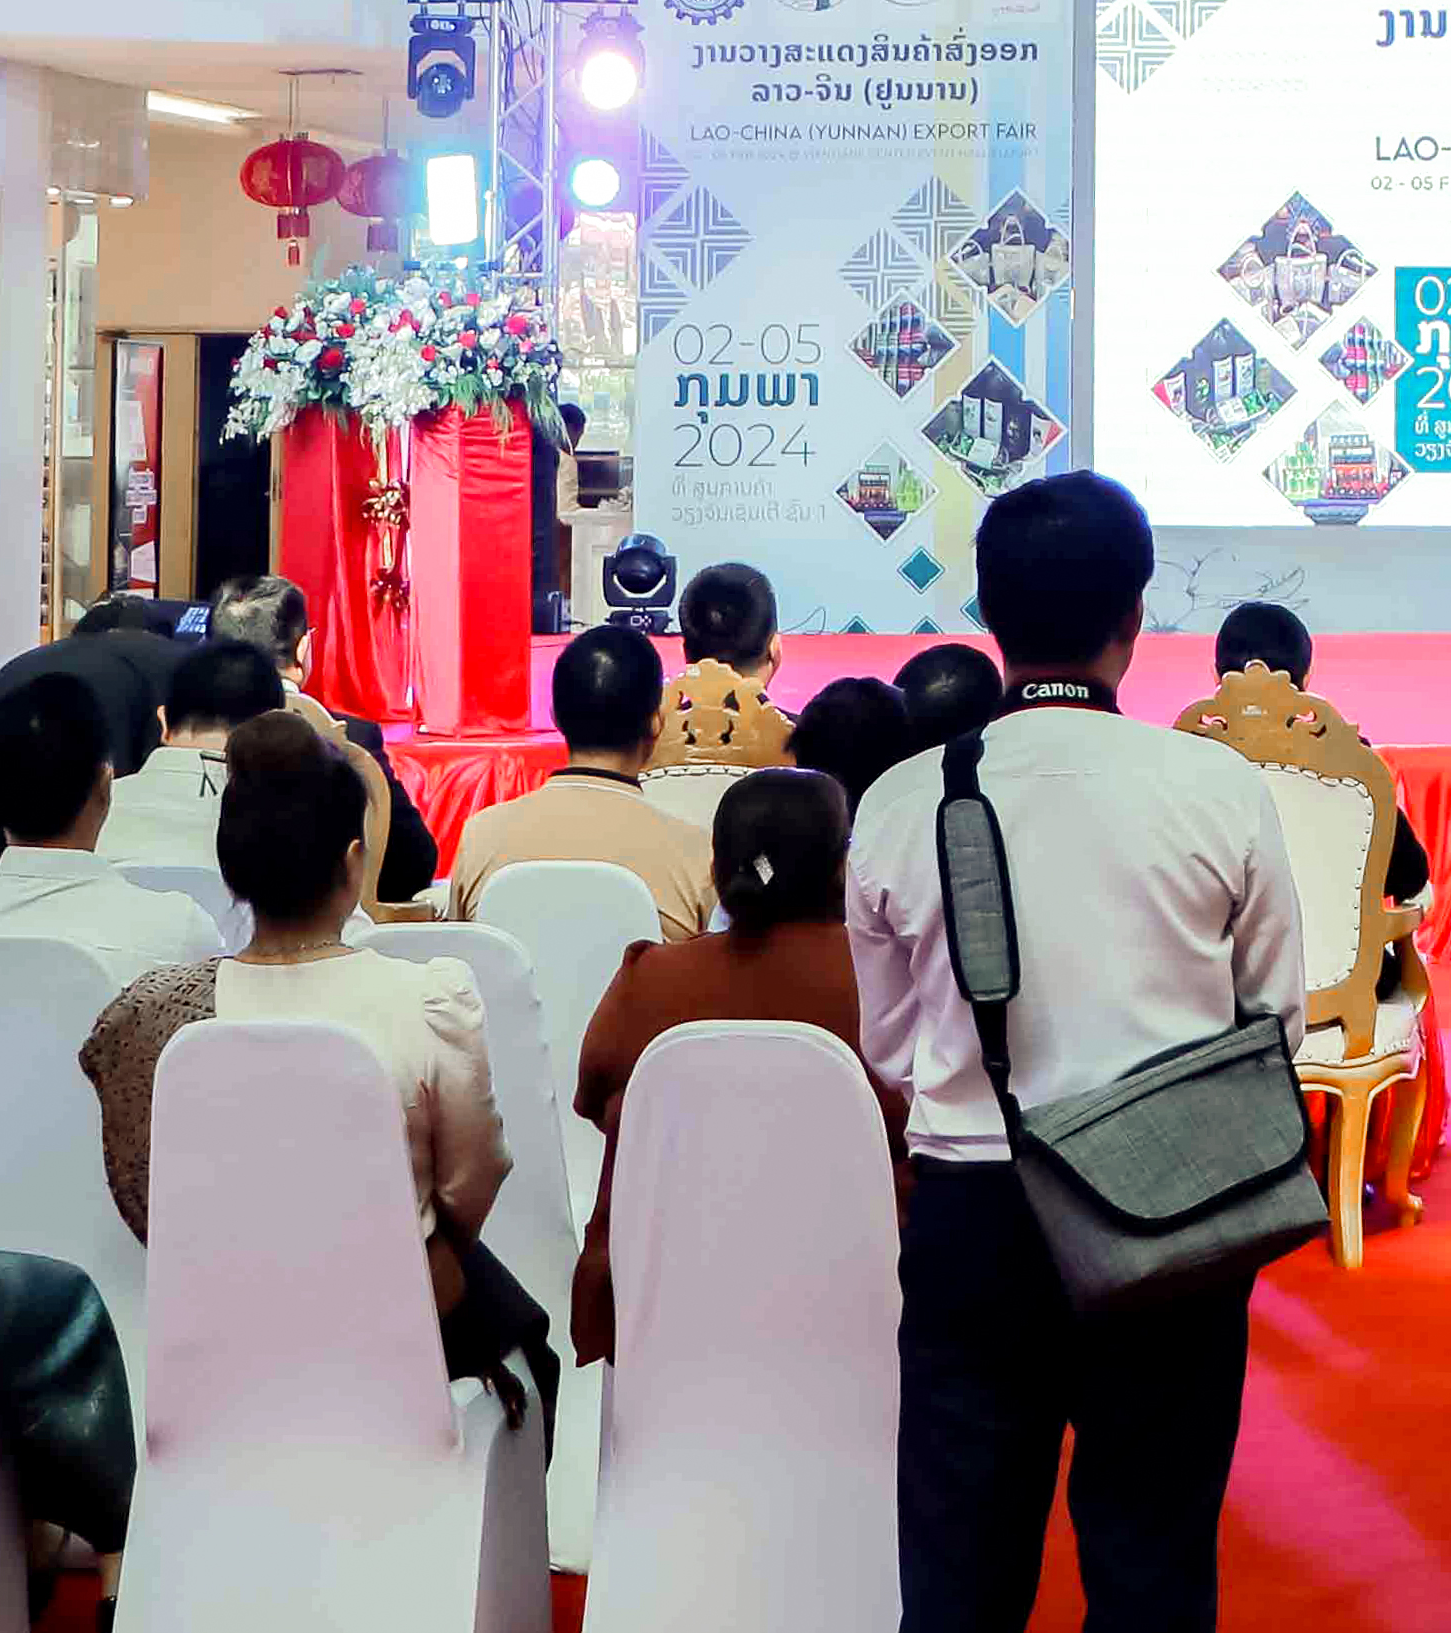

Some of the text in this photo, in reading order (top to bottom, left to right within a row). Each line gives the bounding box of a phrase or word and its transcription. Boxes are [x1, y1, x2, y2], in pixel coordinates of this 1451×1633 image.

[689, 122, 1038, 143] LAO-CHINA (YUNNAN) EXPORT FAIR
[1371, 176, 1394, 191] 02
[1410, 176, 1434, 191] 05
[673, 323, 822, 366] 02-05
[673, 371, 820, 424] ກຸມພາ
[673, 423, 817, 467] 2024
[1021, 682, 1090, 700] Canon
